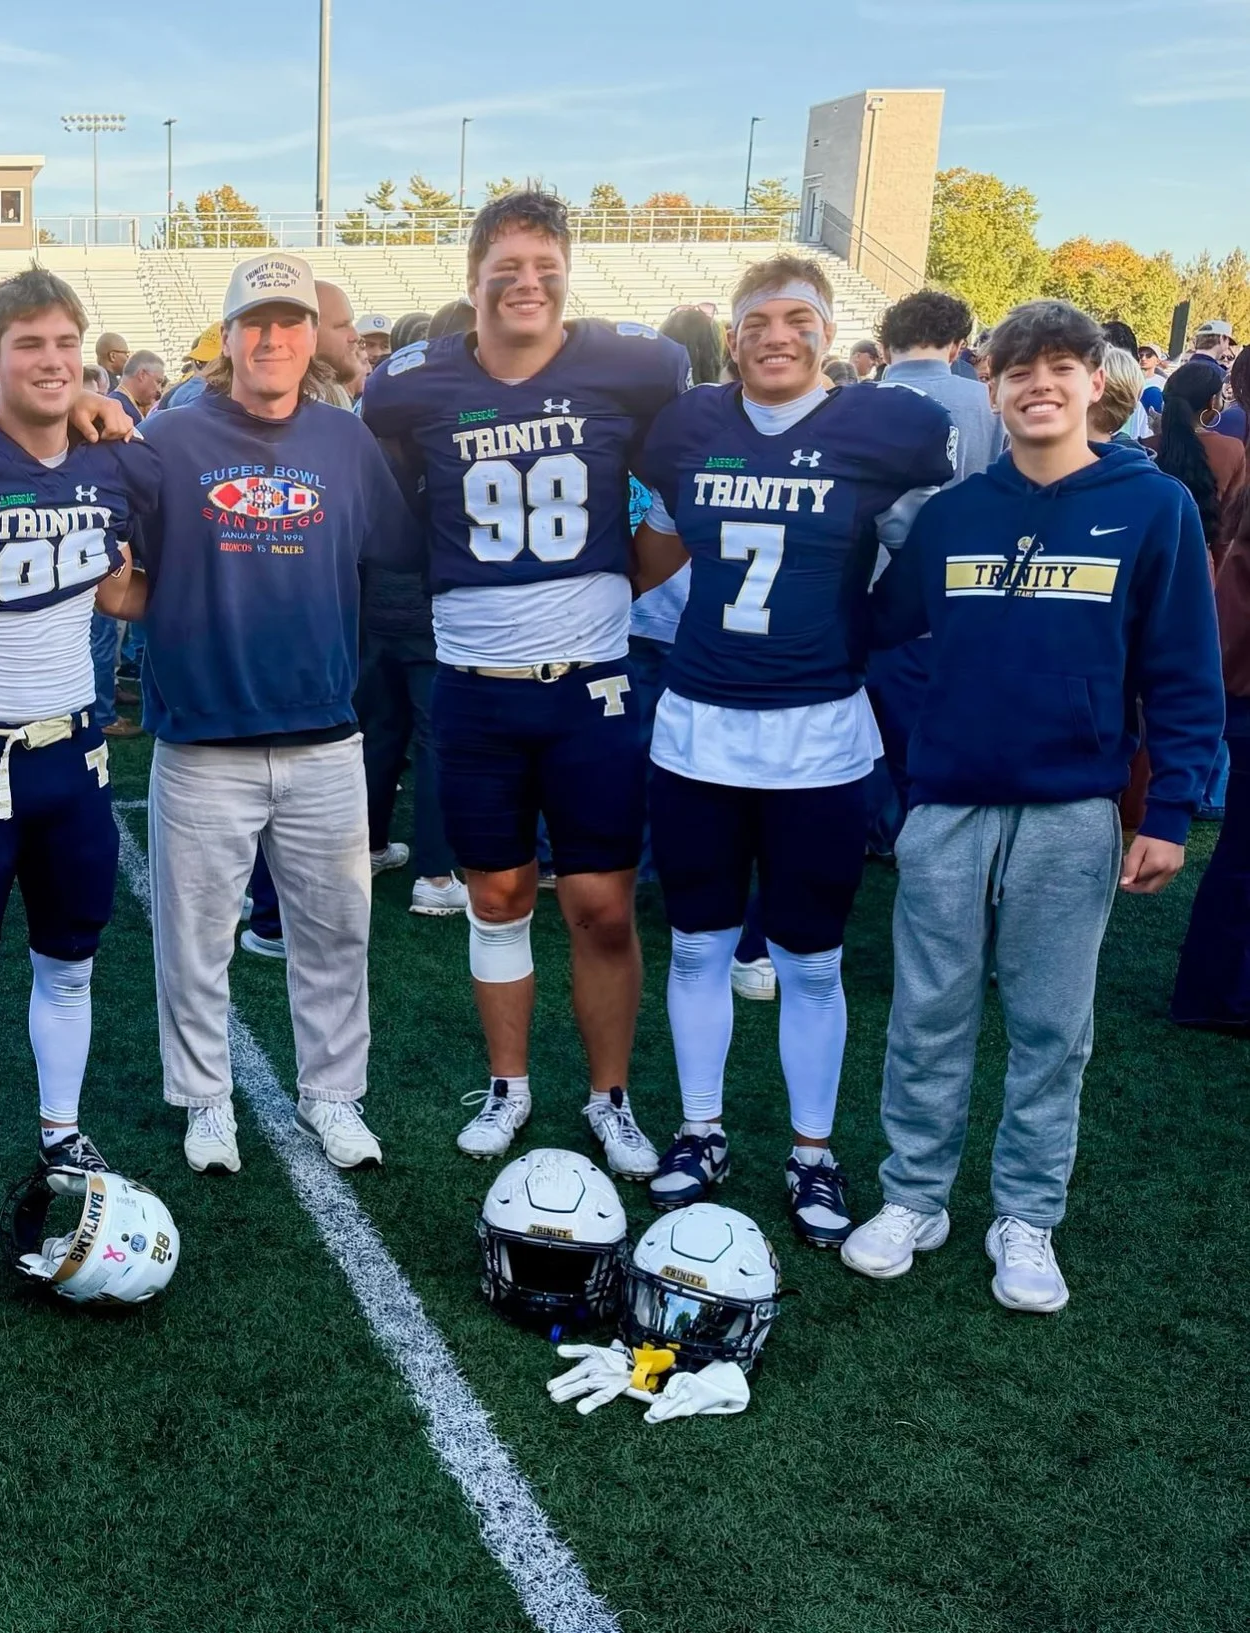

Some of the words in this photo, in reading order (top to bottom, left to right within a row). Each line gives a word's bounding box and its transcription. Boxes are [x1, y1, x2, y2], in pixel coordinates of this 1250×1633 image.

[452, 416, 587, 462] TRINITY
[200, 465, 266, 485] SUPER
[273, 465, 326, 490] BOWL
[462, 452, 590, 563] 98
[693, 473, 835, 513] TRINITY
[202, 507, 246, 529] SAN
[255, 510, 326, 532] DIEGO
[220, 542, 252, 552] BRONCOS
[257, 544, 267, 553] VS
[271, 544, 305, 554] PACKERS
[221, 531, 261, 540] JANUARY
[720, 521, 786, 636] 7
[975, 564, 1078, 588] TRINITY
[586, 674, 631, 717] T
[69, 1191, 105, 1263] BANTAMS
[530, 1224, 569, 1238] TRINITY
[150, 1231, 170, 1264] 82
[664, 1265, 703, 1285] TRINITY
